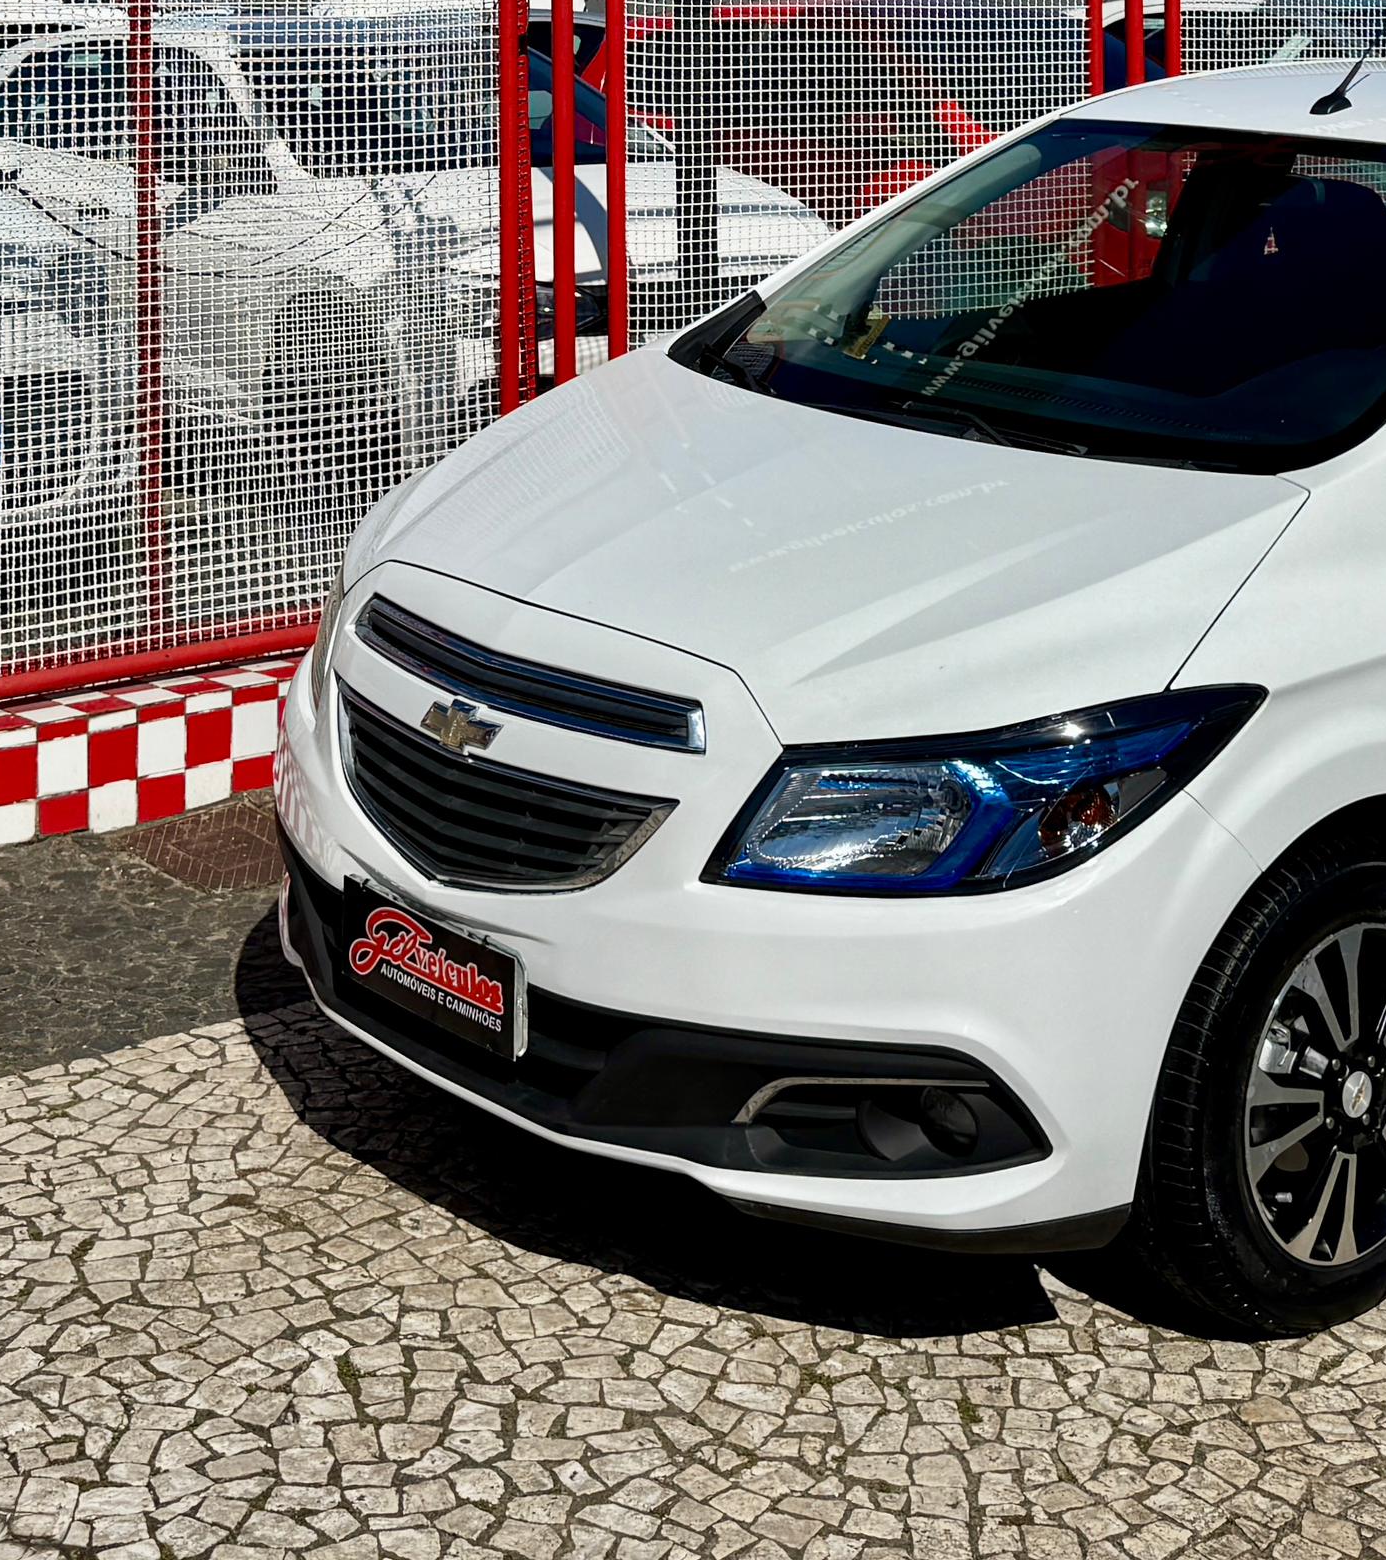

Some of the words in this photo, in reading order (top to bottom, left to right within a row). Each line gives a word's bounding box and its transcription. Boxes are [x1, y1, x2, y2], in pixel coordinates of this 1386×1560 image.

[380, 962, 436, 1001] AUTOMÓVEIS
[437, 991, 445, 1005] E
[445, 996, 503, 1033] CAMINHÕES
